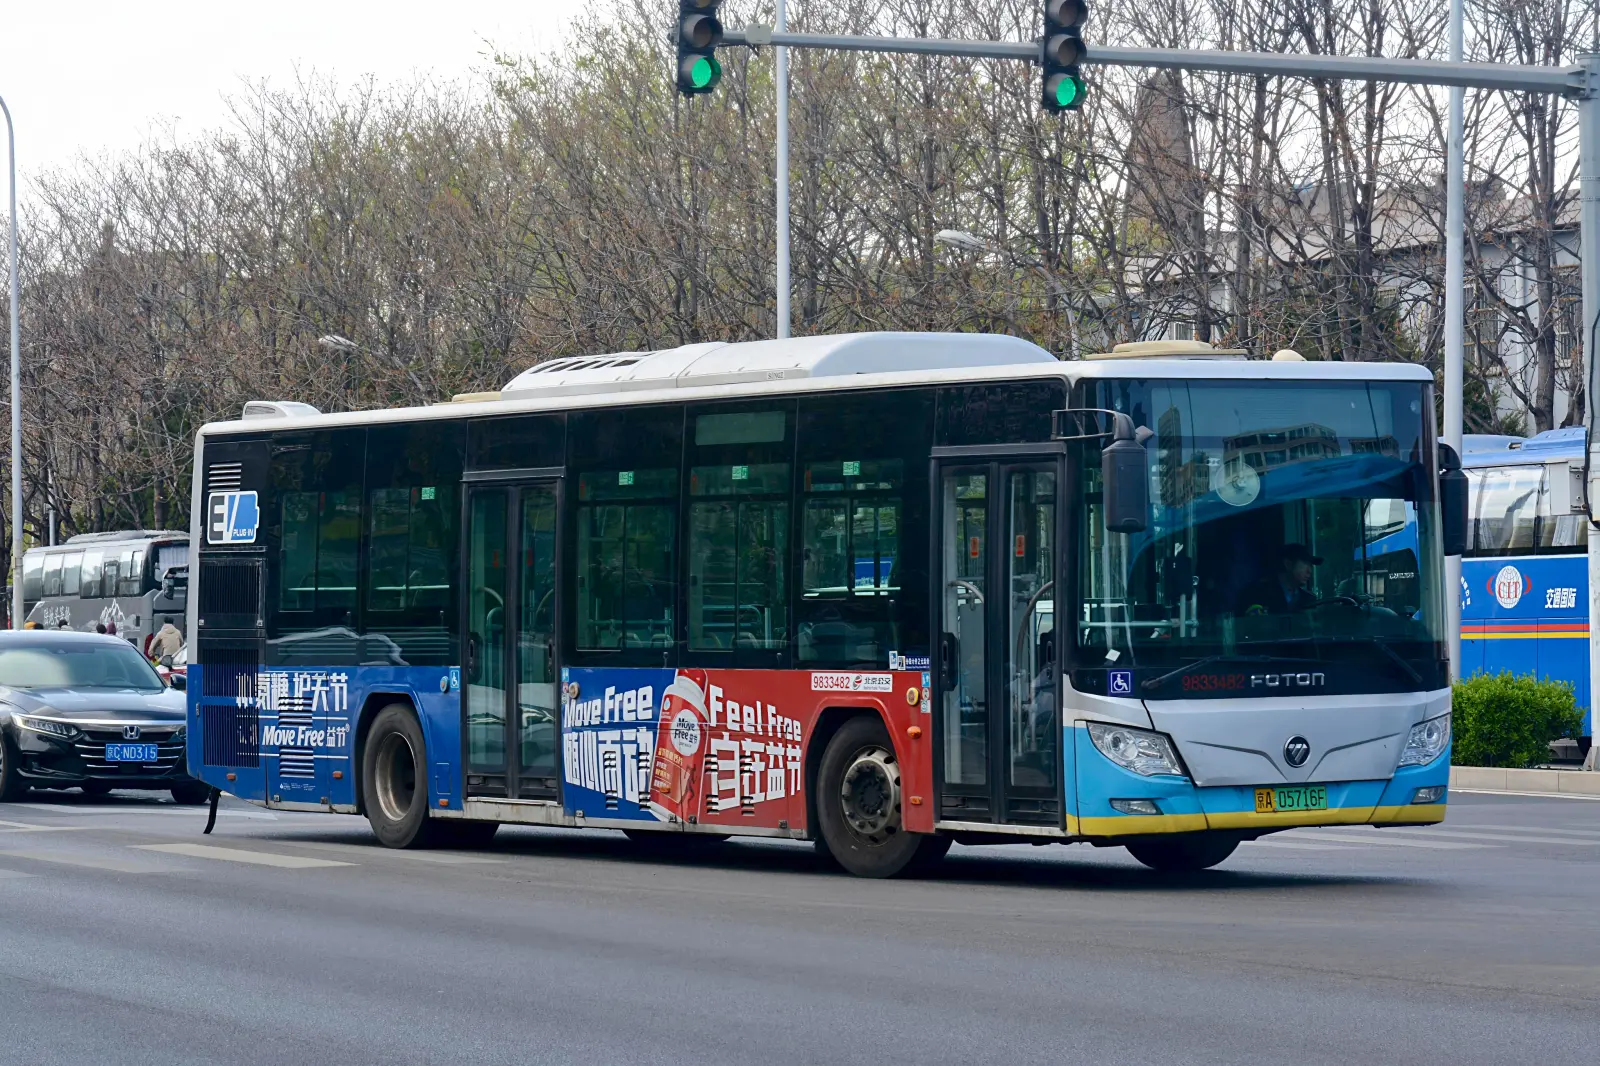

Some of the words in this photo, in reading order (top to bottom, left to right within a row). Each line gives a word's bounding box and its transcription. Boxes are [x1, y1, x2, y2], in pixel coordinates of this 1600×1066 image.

[1498, 581, 1520, 599] CIT
[813, 675, 851, 689] 9833482
[1181, 674, 1245, 691] 9833482
[1251, 672, 1325, 688] FOTON
[562, 698, 602, 728] Move
[603, 685, 653, 724] Free
[709, 683, 763, 736] Feel
[767, 703, 802, 742] Free
[262, 725, 296, 747] Move
[297, 726, 325, 747] Free
[710, 731, 802, 811] 自在益节
